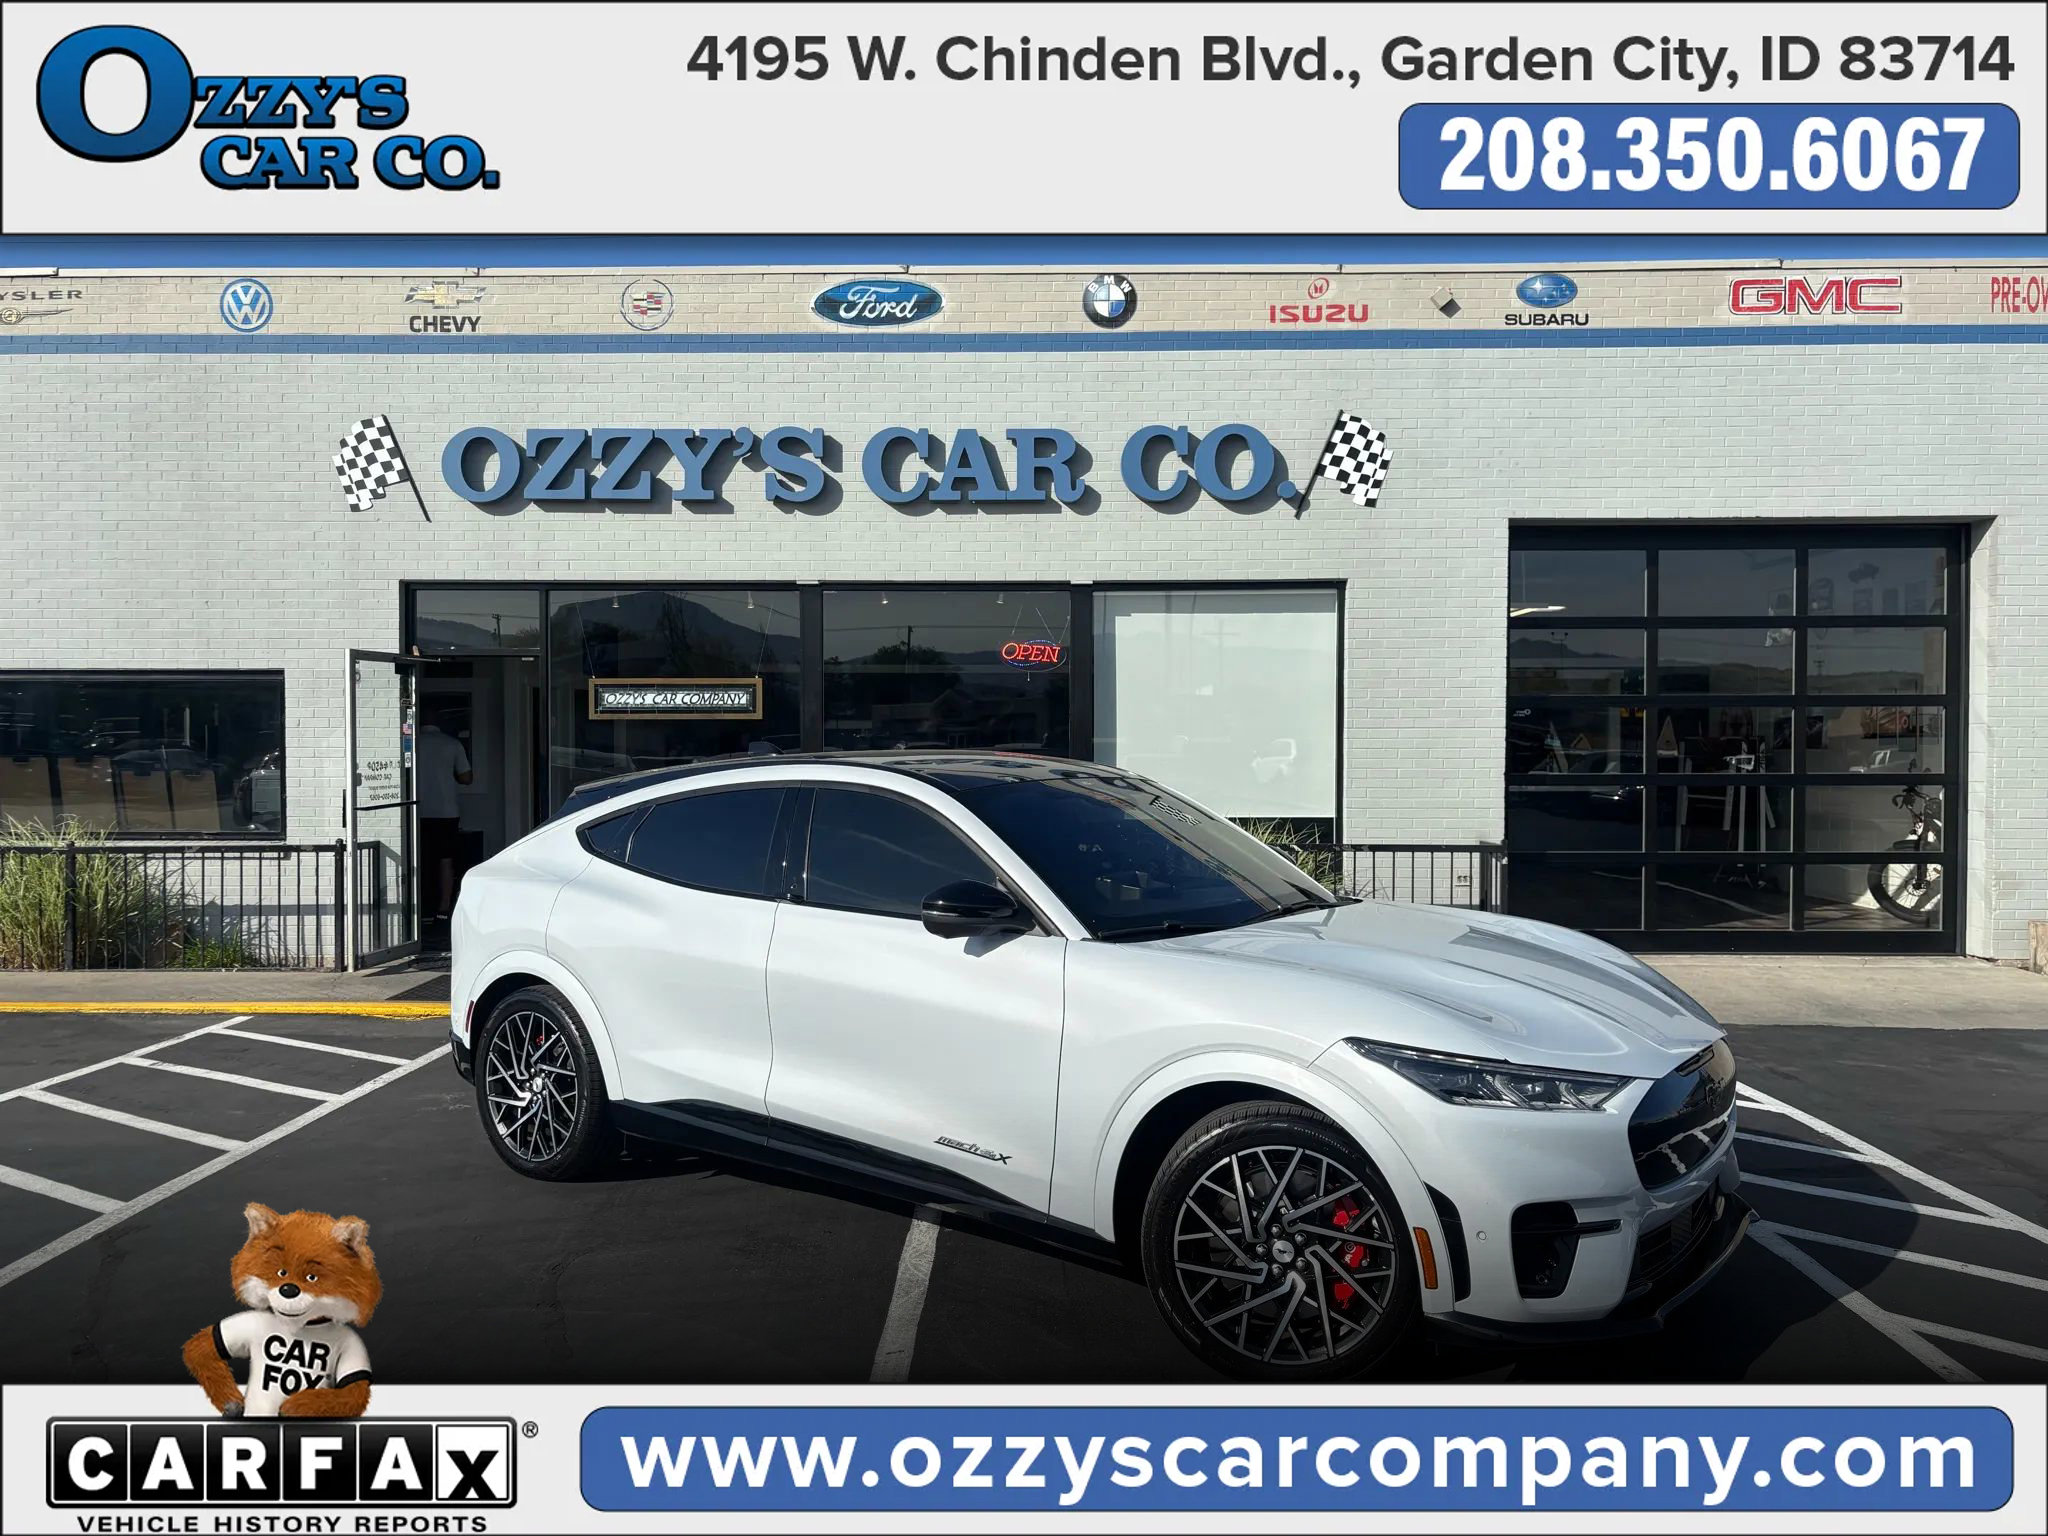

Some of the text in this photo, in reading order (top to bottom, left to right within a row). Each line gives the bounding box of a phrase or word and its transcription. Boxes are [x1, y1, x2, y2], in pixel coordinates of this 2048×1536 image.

[1088, 274, 1132, 293] BMW
[839, 286, 917, 320] Ford
[1729, 276, 1903, 315] GMC
[1270, 304, 1369, 323] ISUZU
[1505, 314, 1589, 326] SUBARU
[409, 315, 481, 333] CHEVY
[441, 423, 1297, 503] OZZY'S CAR CO.
[1002, 642, 1061, 663] OPEN
[606, 693, 745, 705] OZZY'S CAR COMPANY
